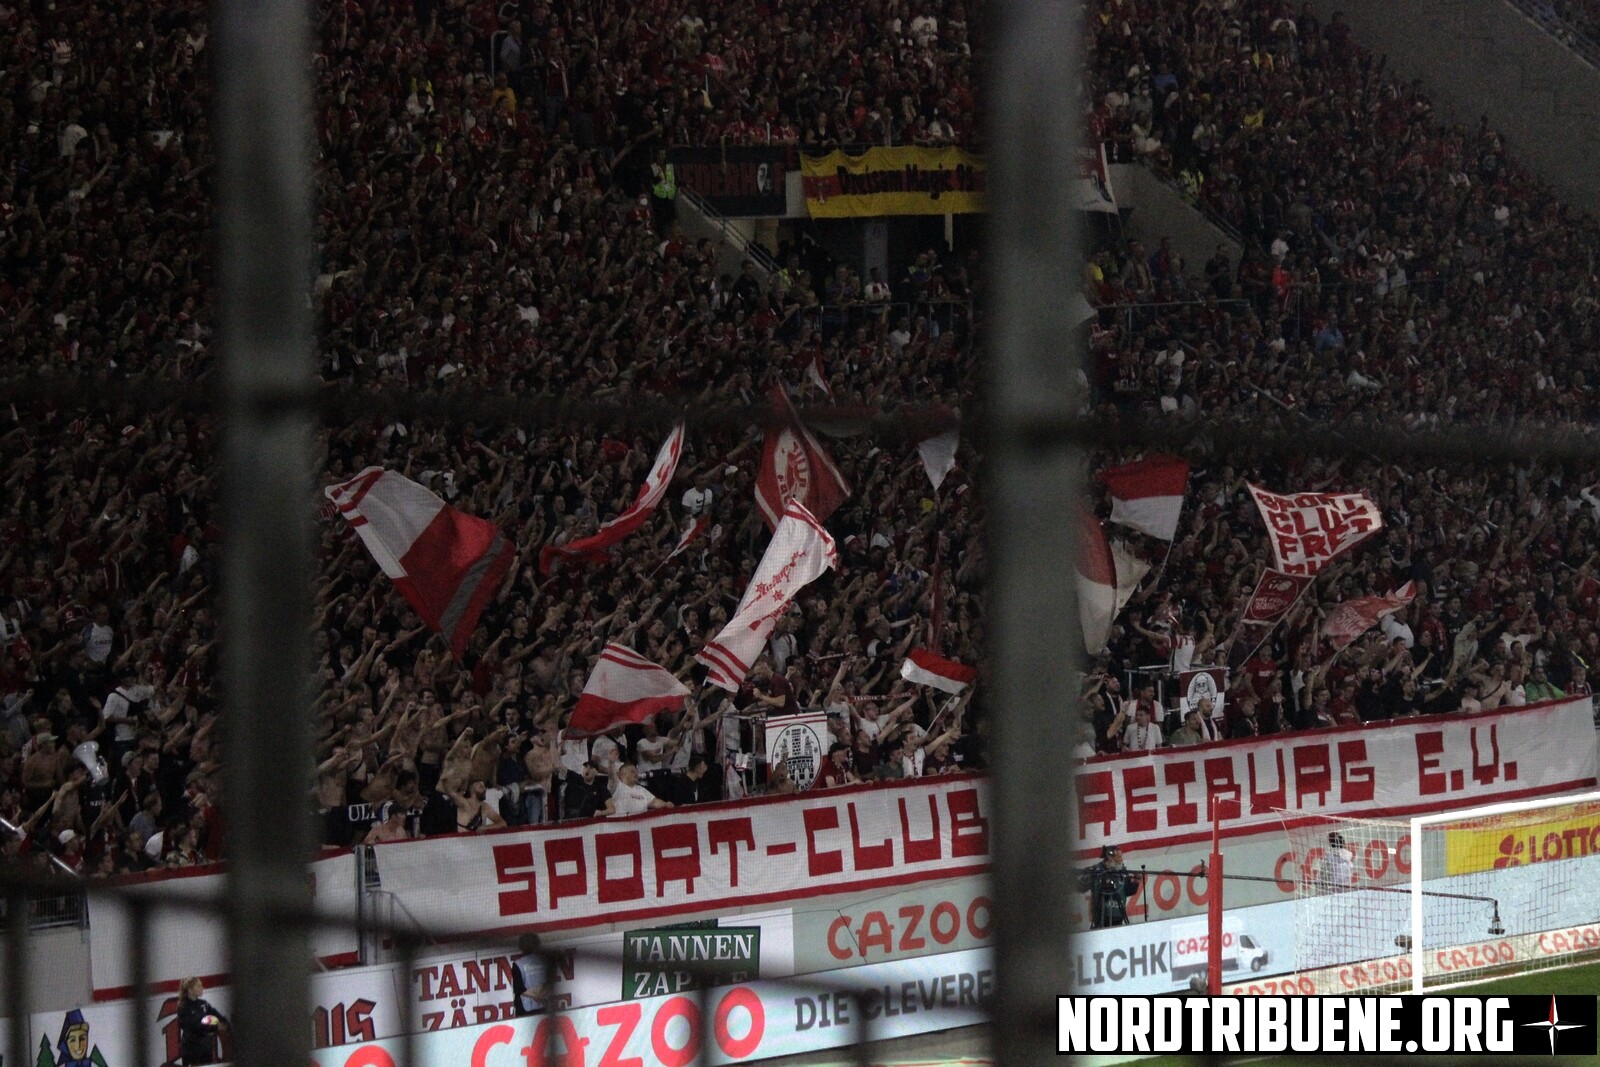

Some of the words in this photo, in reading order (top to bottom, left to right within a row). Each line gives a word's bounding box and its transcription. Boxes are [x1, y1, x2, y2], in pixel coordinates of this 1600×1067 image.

[1076, 739, 1376, 842] REIBURG
[491, 788, 990, 917] SPORT-CLUB
[629, 933, 754, 963] TANNEN
[826, 895, 996, 961] CAZOO
[1176, 931, 1233, 956] CAZO
[412, 947, 577, 1002] TANNN
[1070, 940, 1170, 987] LICHK
[1436, 940, 1514, 971] CAZOO
[793, 990, 851, 1032] DIE
